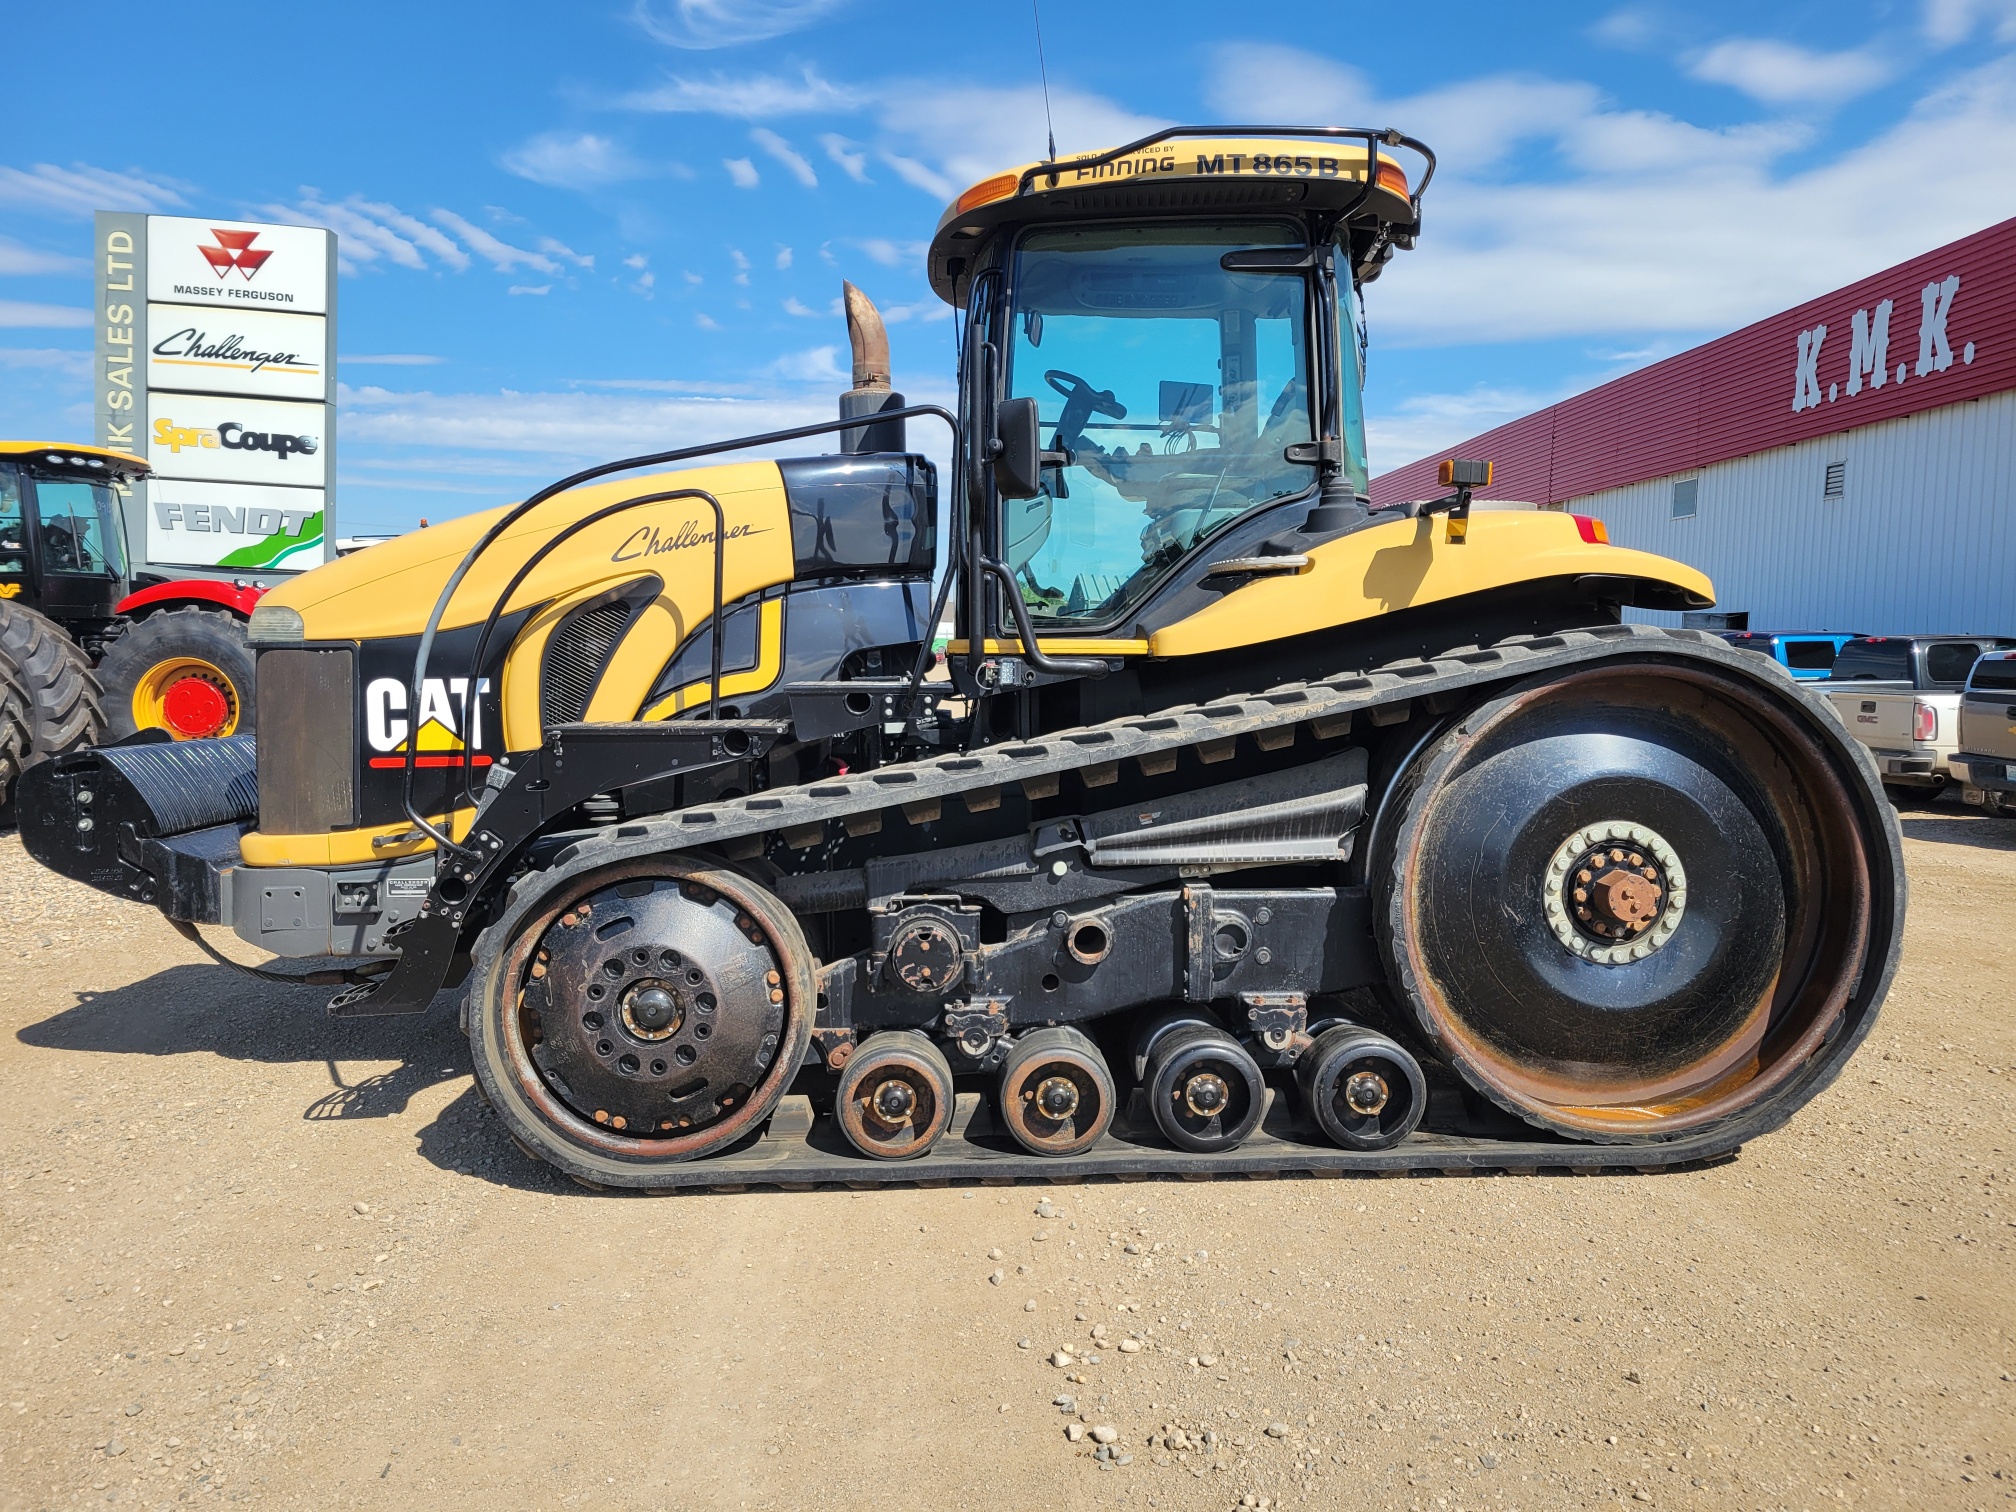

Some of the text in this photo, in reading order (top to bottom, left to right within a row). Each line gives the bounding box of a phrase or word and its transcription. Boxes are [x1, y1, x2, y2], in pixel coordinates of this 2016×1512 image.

[1196, 153, 1247, 174] MT
[107, 230, 134, 291] LTD
[173, 284, 294, 303] MASSEY FERGUSON
[107, 303, 134, 411] SALES
[152, 328, 320, 373] Challenger
[153, 418, 319, 460] SpraCoupe
[153, 502, 316, 538] FENDT
[611, 519, 775, 562] Challener
[366, 677, 490, 752] CAT
[1857, 715, 1879, 724] GMC
